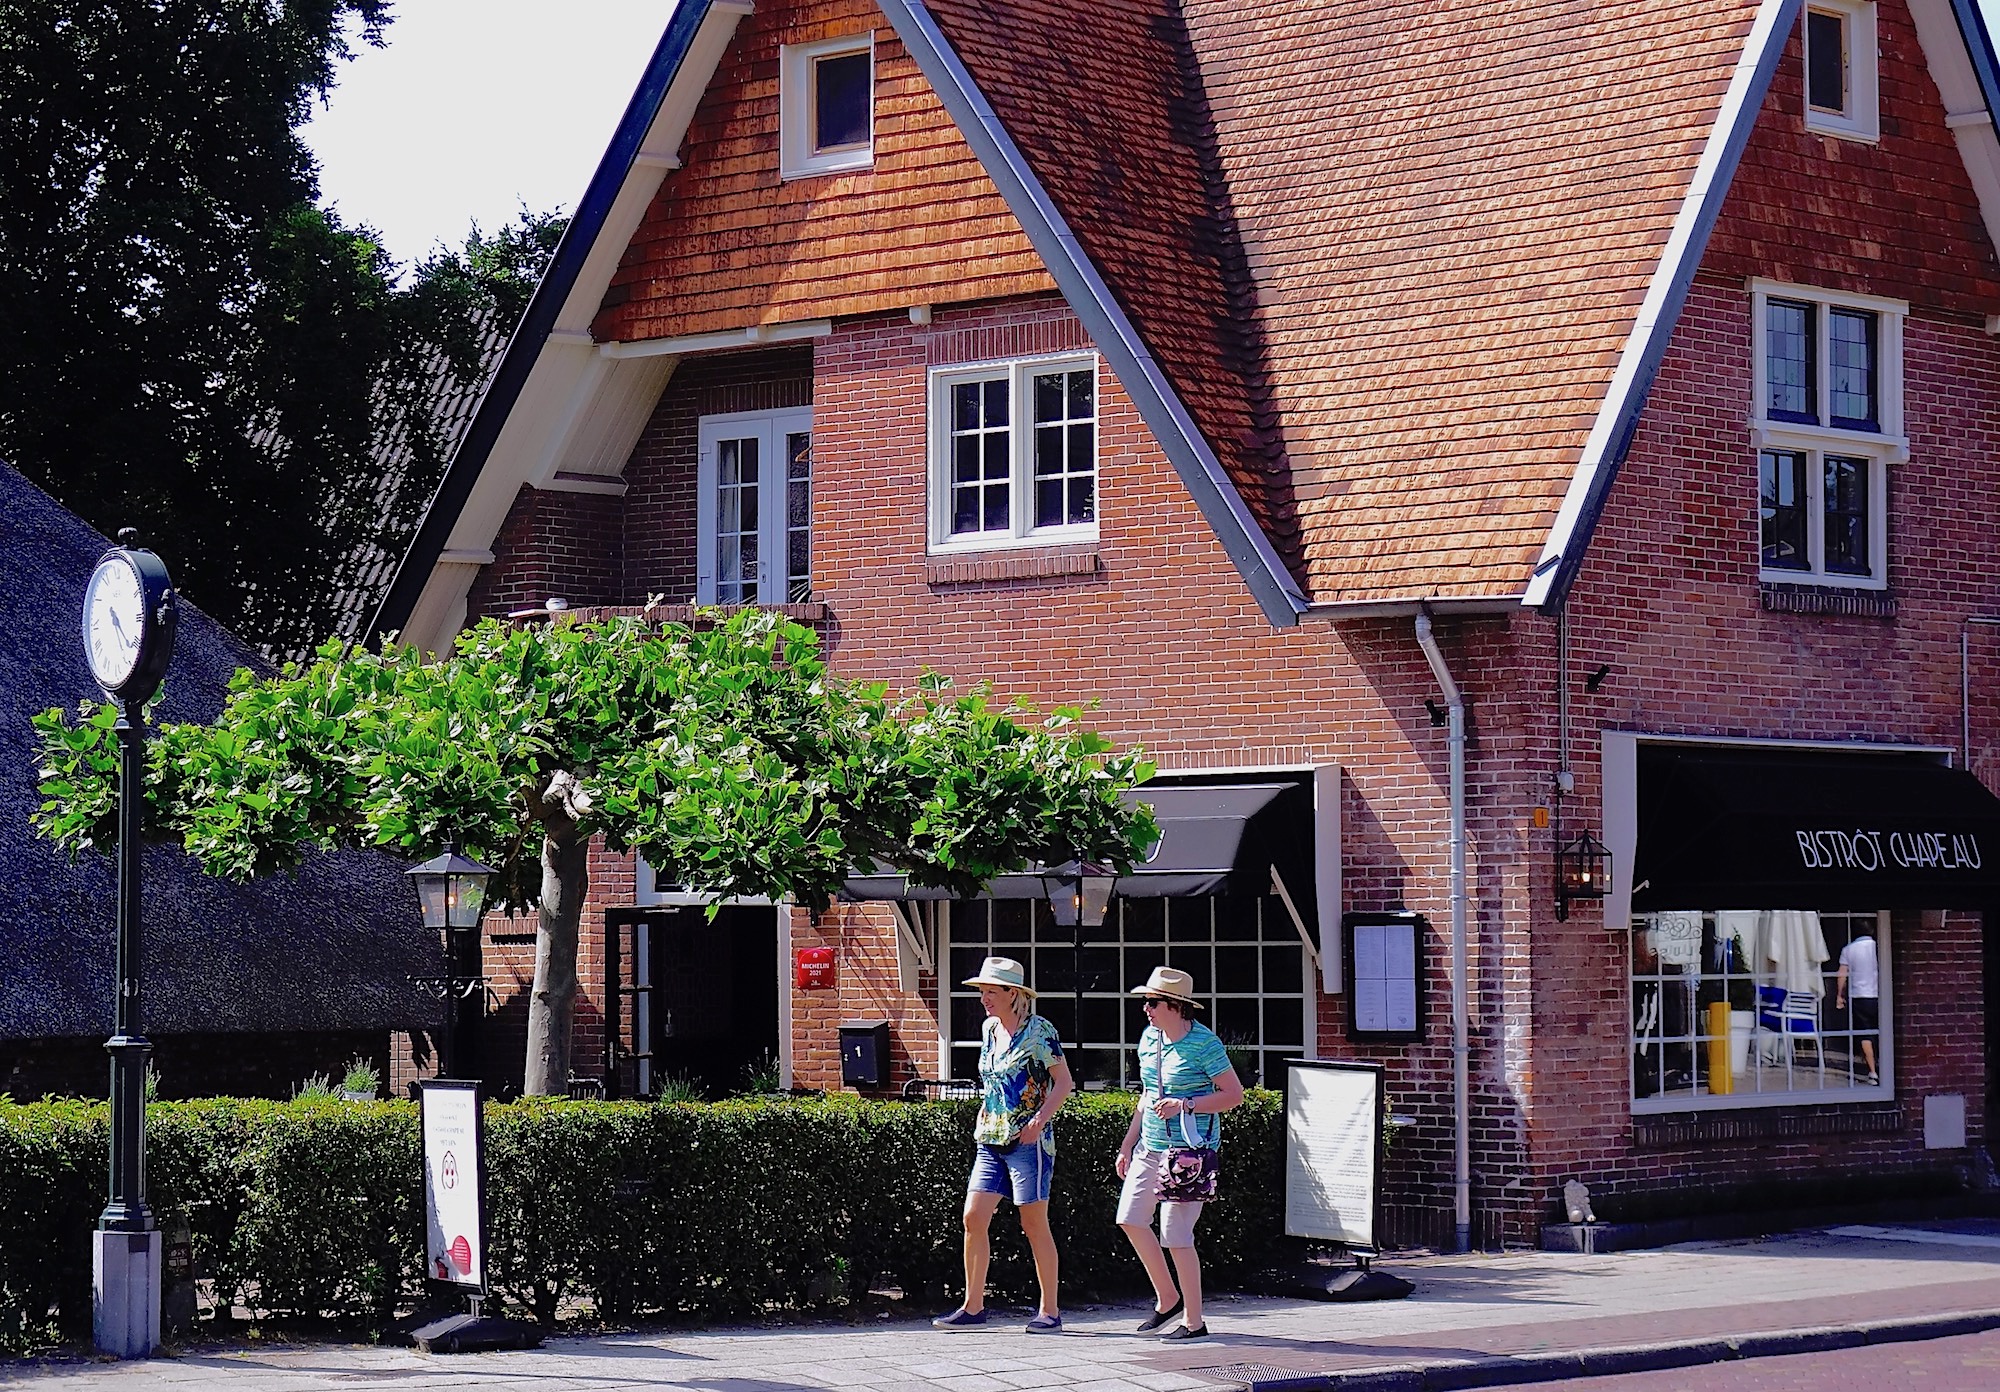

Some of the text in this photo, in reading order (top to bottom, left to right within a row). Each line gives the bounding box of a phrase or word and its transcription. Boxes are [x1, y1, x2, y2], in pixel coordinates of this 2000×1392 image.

[1796, 828, 1981, 871] BISTRÔT CHAPEAU
[855, 1045, 862, 1058] 1
